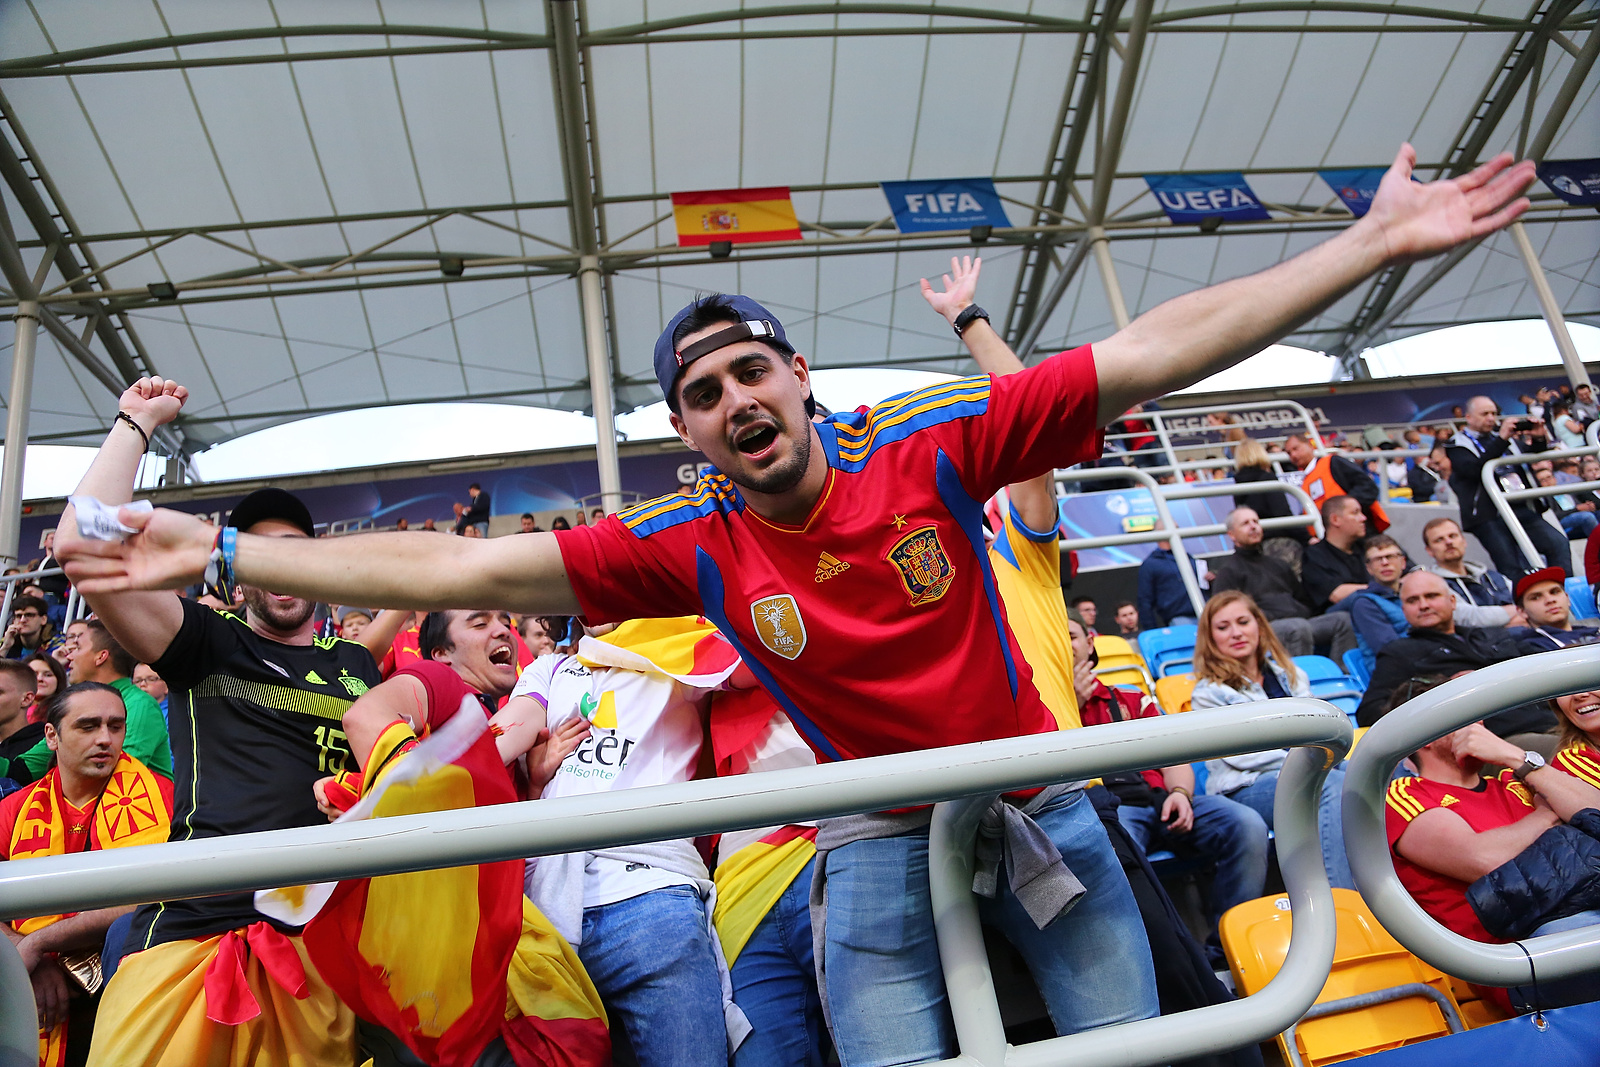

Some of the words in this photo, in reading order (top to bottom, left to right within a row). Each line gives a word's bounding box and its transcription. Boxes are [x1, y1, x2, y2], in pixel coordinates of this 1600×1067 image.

[904, 192, 984, 213] FIFA
[1158, 187, 1256, 210] UEFA
[814, 561, 851, 583] adidas
[774, 636, 794, 645] FIFA
[313, 725, 350, 775] 15
